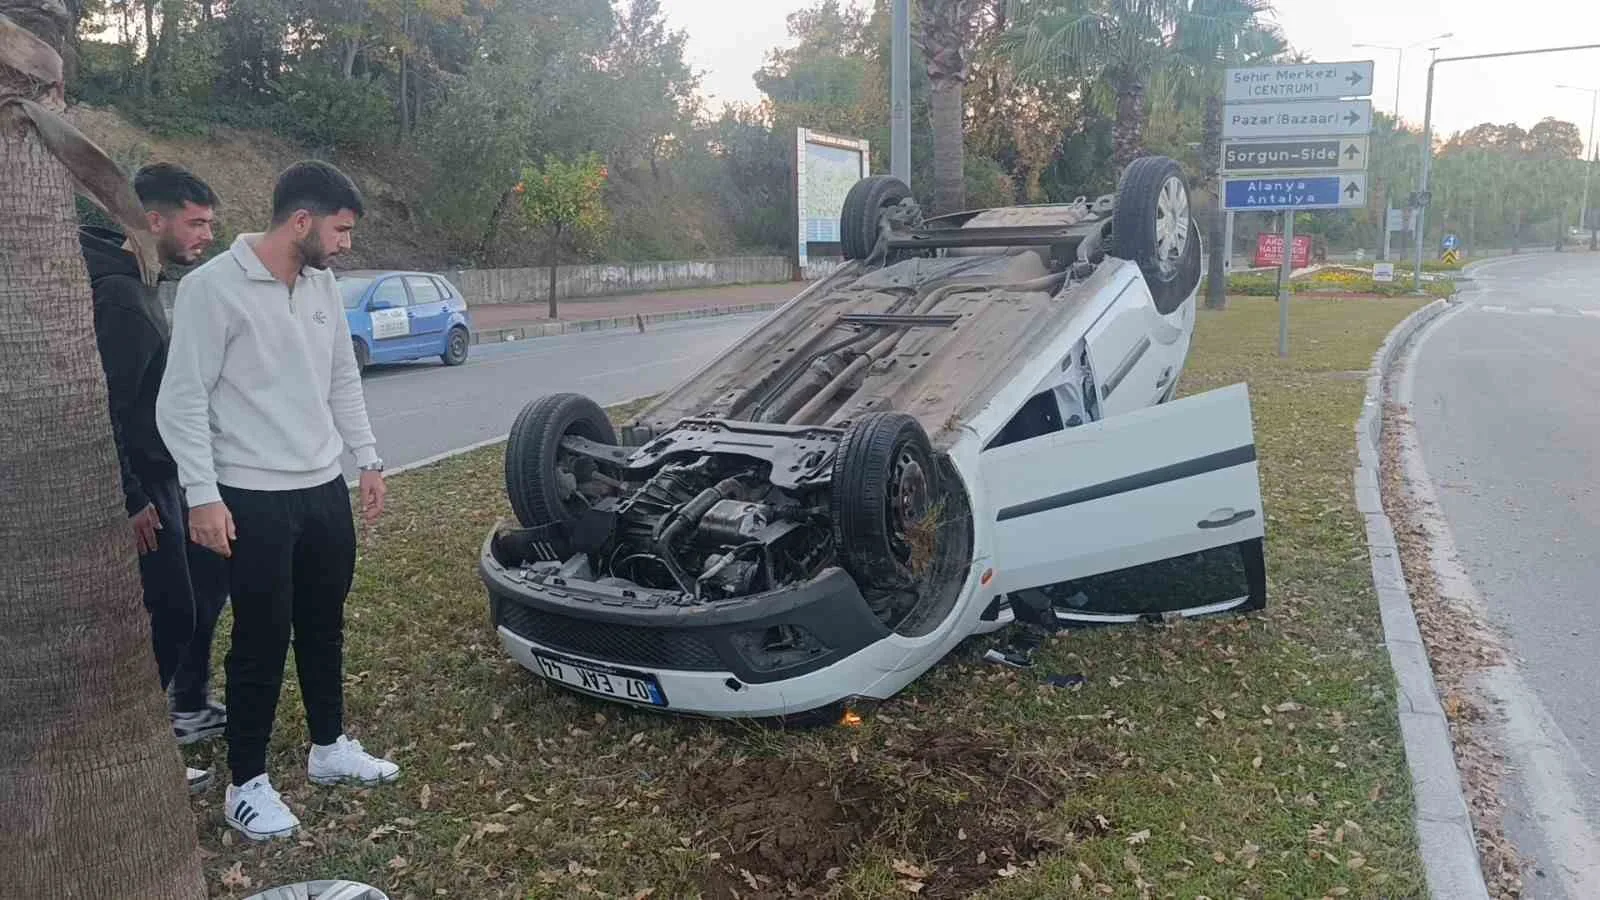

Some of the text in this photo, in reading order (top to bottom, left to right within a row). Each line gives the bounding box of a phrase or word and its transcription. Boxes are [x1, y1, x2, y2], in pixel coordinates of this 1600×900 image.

[1276, 69, 1337, 81] Merkezi
[1249, 83, 1319, 96] (CENTRUM)
[1227, 148, 1337, 163] Sorgun-Side
[1248, 181, 1305, 193] Alanya
[1247, 193, 1316, 205] Antalya
[541, 658, 563, 680] 44
[576, 668, 614, 693] EAK
[626, 679, 648, 699] 07
